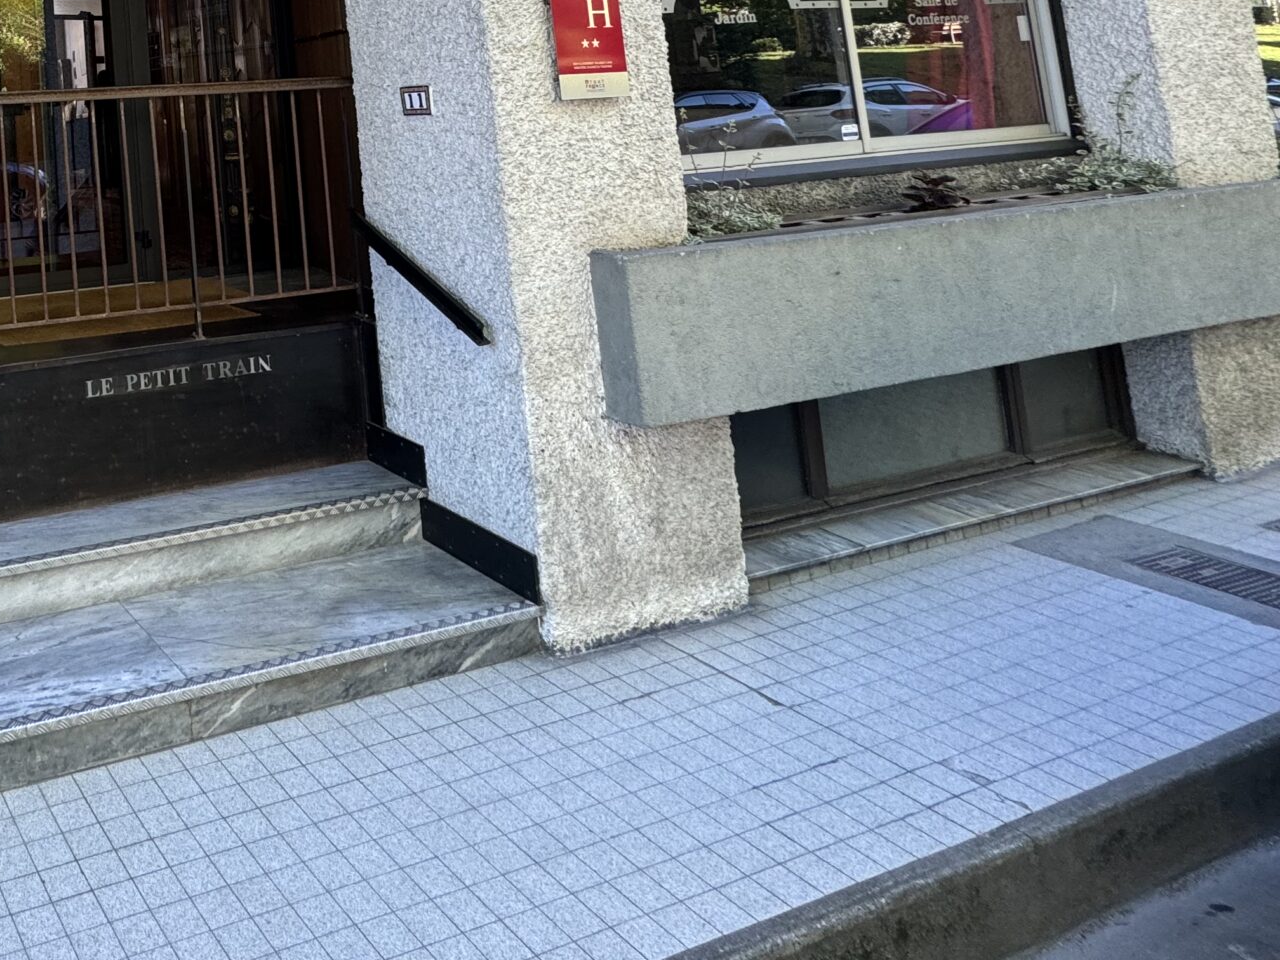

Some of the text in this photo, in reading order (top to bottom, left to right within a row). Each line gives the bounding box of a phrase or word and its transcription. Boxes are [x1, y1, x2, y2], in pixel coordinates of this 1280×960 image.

[714, 11, 758, 25] Jardin
[907, 12, 970, 26] Conférence
[407, 93, 426, 109] 11
[86, 353, 273, 399] LE PETIT TRAIN
